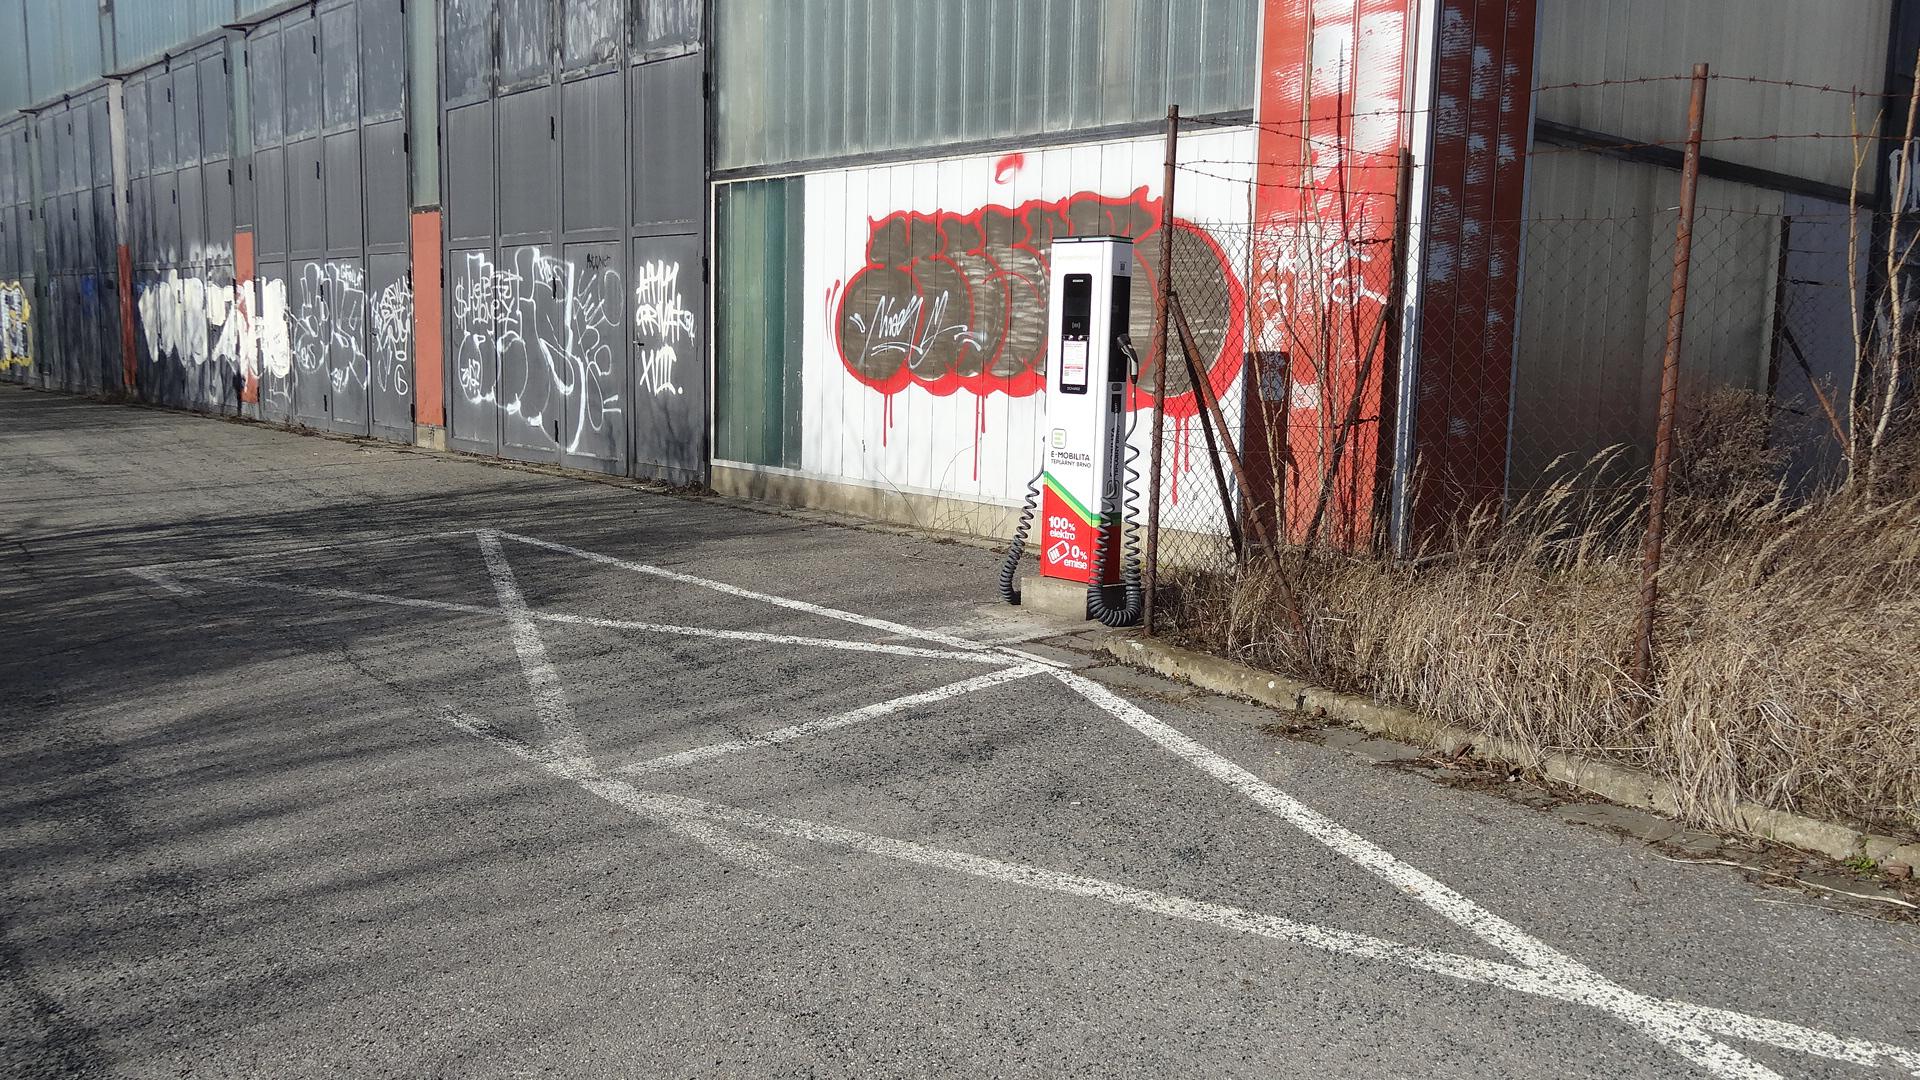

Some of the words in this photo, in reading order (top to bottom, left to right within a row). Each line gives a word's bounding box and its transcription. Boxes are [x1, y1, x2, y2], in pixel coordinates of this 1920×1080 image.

[1051, 451, 1090, 461] E-MOBILITA
[1049, 516, 1076, 531] 100%
[1049, 529, 1075, 540] elektro
[1071, 545, 1087, 560] 0%
[1064, 559, 1087, 569] emise
